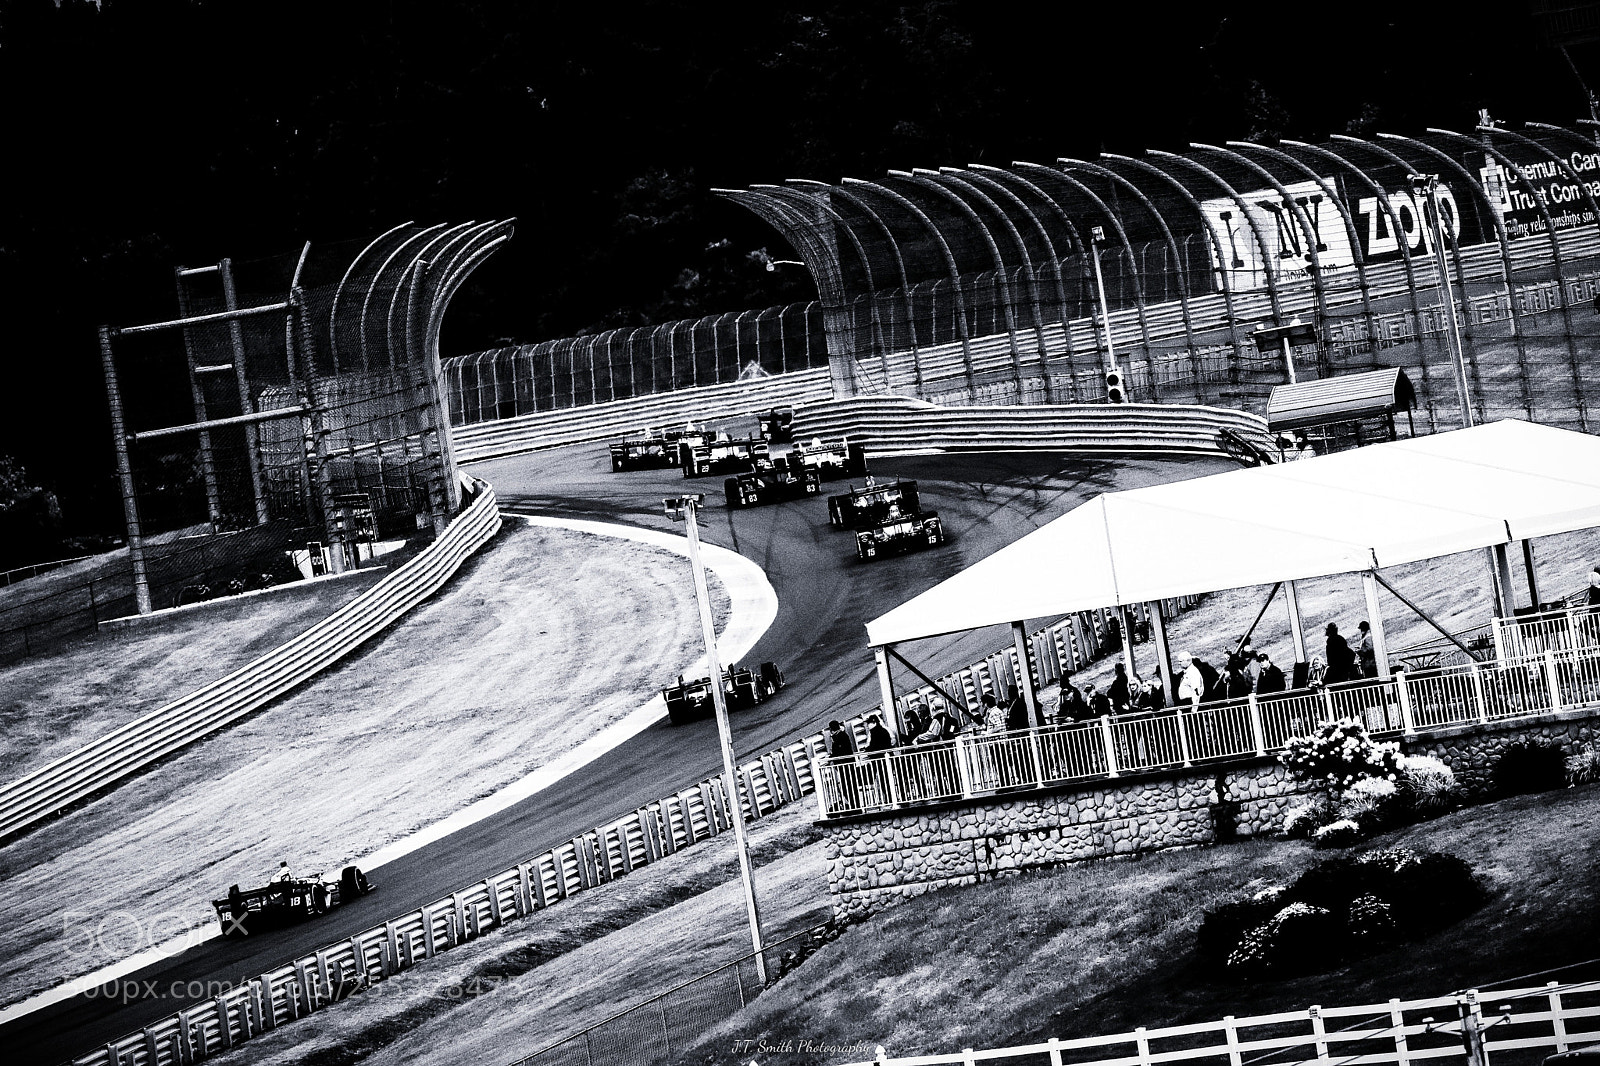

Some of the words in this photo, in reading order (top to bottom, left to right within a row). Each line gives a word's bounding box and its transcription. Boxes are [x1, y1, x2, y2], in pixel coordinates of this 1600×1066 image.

[1530, 209, 1581, 233] relaonships
[806, 484, 815, 492] 83
[748, 494, 757, 502] 83
[928, 535, 937, 544] 15
[867, 548, 876, 556] 15
[290, 897, 301, 907] 18
[221, 912, 232, 921] 18
